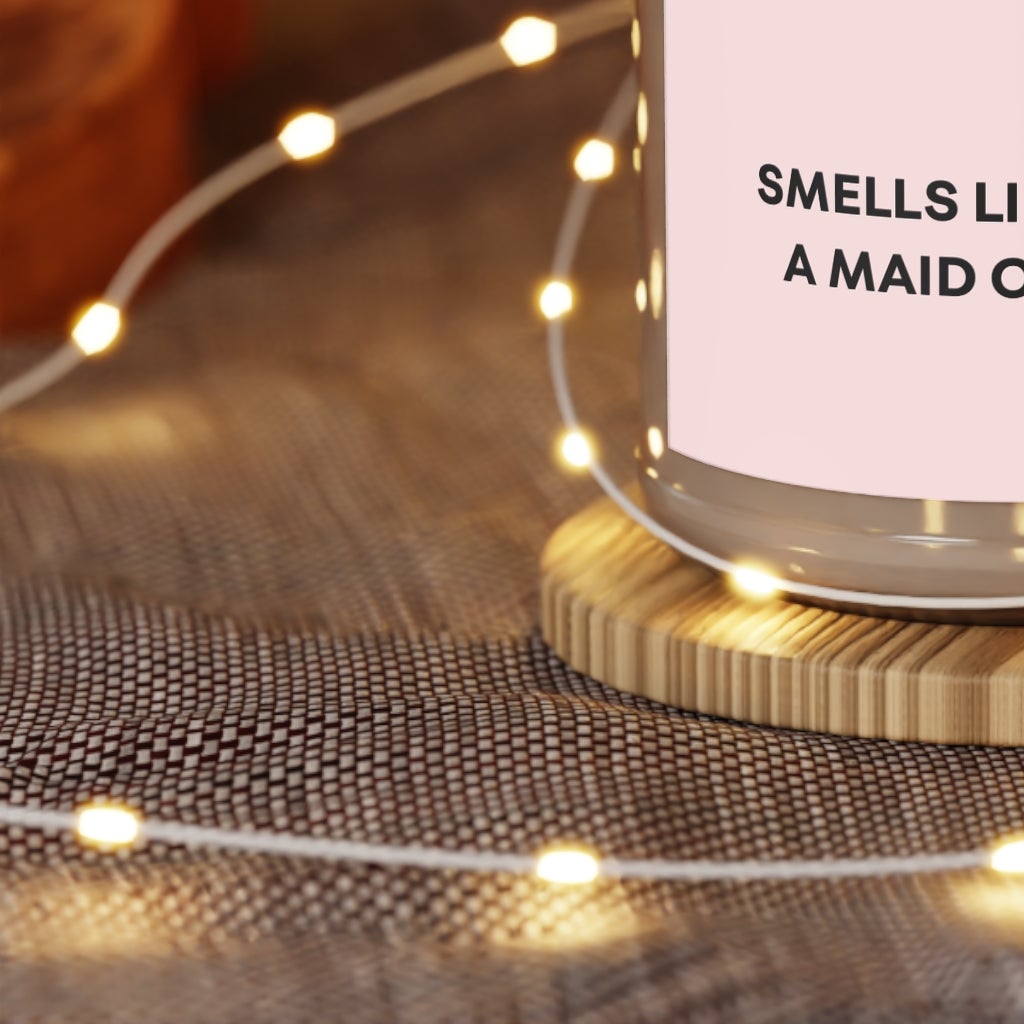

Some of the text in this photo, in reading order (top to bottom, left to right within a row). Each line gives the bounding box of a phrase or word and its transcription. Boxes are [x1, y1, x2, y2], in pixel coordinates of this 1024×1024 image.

[757, 163, 958, 223] SMELLS
[783, 242, 818, 286] A
[828, 247, 977, 297] MAID
